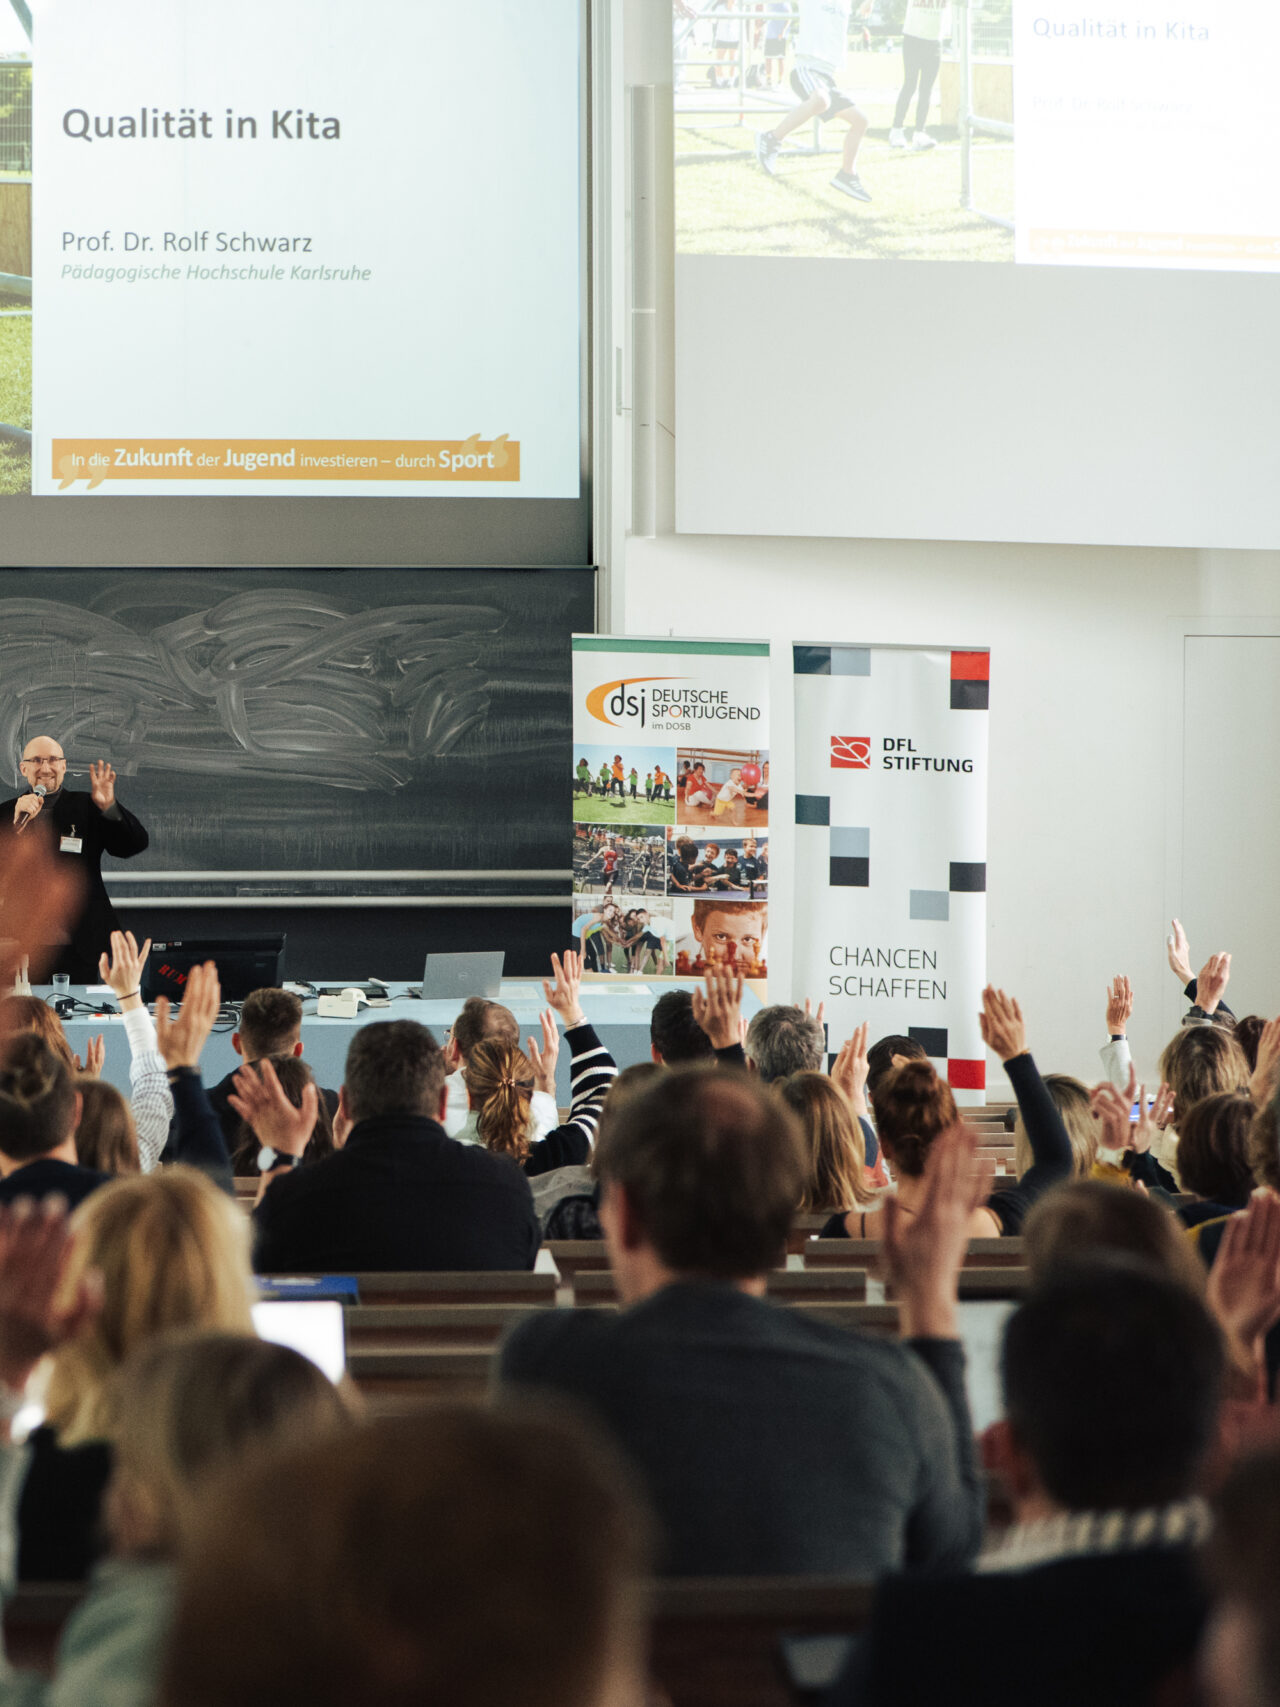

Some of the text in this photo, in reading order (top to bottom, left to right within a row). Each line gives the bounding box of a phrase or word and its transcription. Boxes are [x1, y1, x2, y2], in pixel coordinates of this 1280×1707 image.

[62, 107, 341, 143] Qualität in Kita
[62, 230, 313, 252] Prof. Dr. Rolf Schwarz
[60, 264, 372, 283] Pädagogische Hochschule Karlsruhe
[71, 452, 87, 467] In
[90, 452, 110, 467] die
[113, 447, 193, 468] Zukunft
[196, 452, 220, 467] der
[223, 448, 296, 472] Jugend
[300, 453, 379, 468] investieren
[395, 453, 436, 468] durch
[438, 449, 495, 473] Sport
[611, 683, 646, 729] dsj
[652, 688, 729, 704] DEUTSCHE
[652, 704, 761, 720] SPORTJUGEND
[651, 722, 692, 731] im DOSB
[882, 737, 917, 752] DFL
[882, 756, 974, 773] STIFTUNG
[829, 945, 937, 970] CHANCEN
[828, 976, 947, 1000] SCHAFFEN
